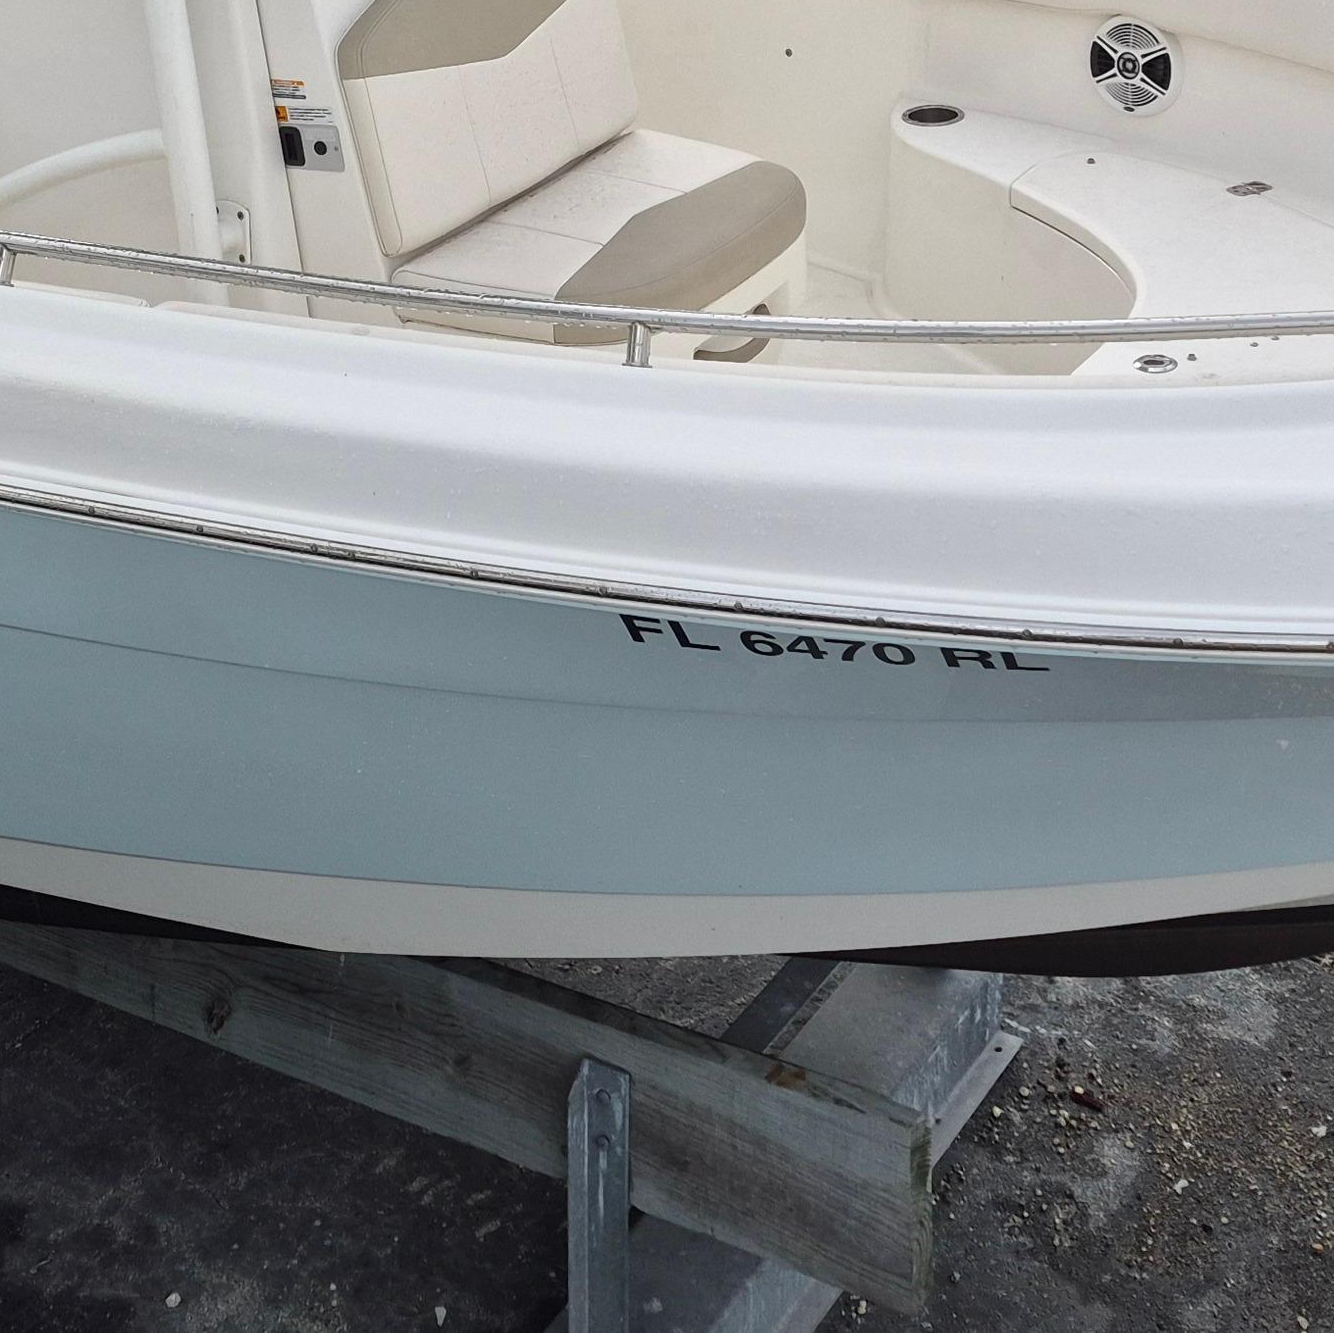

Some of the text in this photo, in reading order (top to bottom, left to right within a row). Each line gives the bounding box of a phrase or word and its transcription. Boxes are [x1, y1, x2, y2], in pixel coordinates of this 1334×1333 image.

[618, 613, 1051, 672] FL 6470 RL
